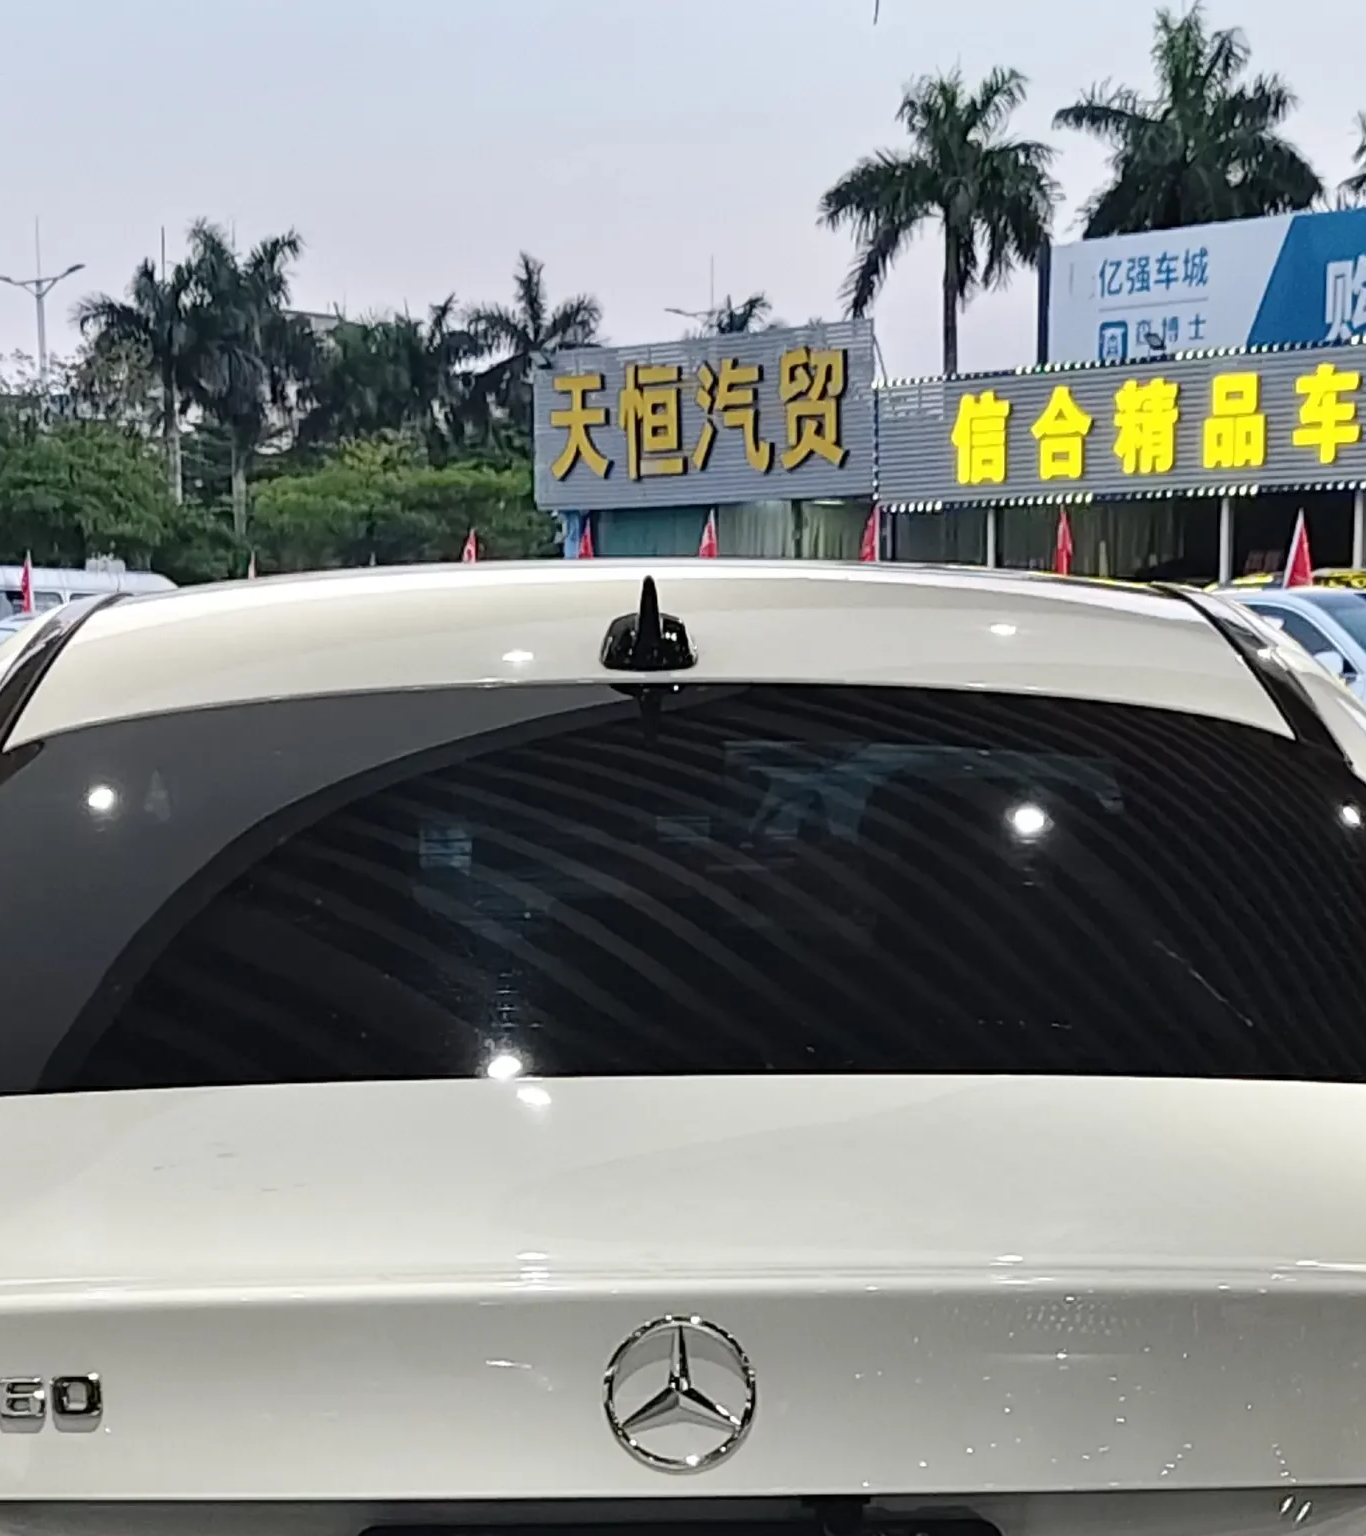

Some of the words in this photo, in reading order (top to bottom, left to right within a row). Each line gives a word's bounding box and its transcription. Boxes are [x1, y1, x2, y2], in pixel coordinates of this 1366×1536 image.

[1099, 246, 1209, 299] 亿强车城
[551, 346, 848, 481] 天恒汽贸
